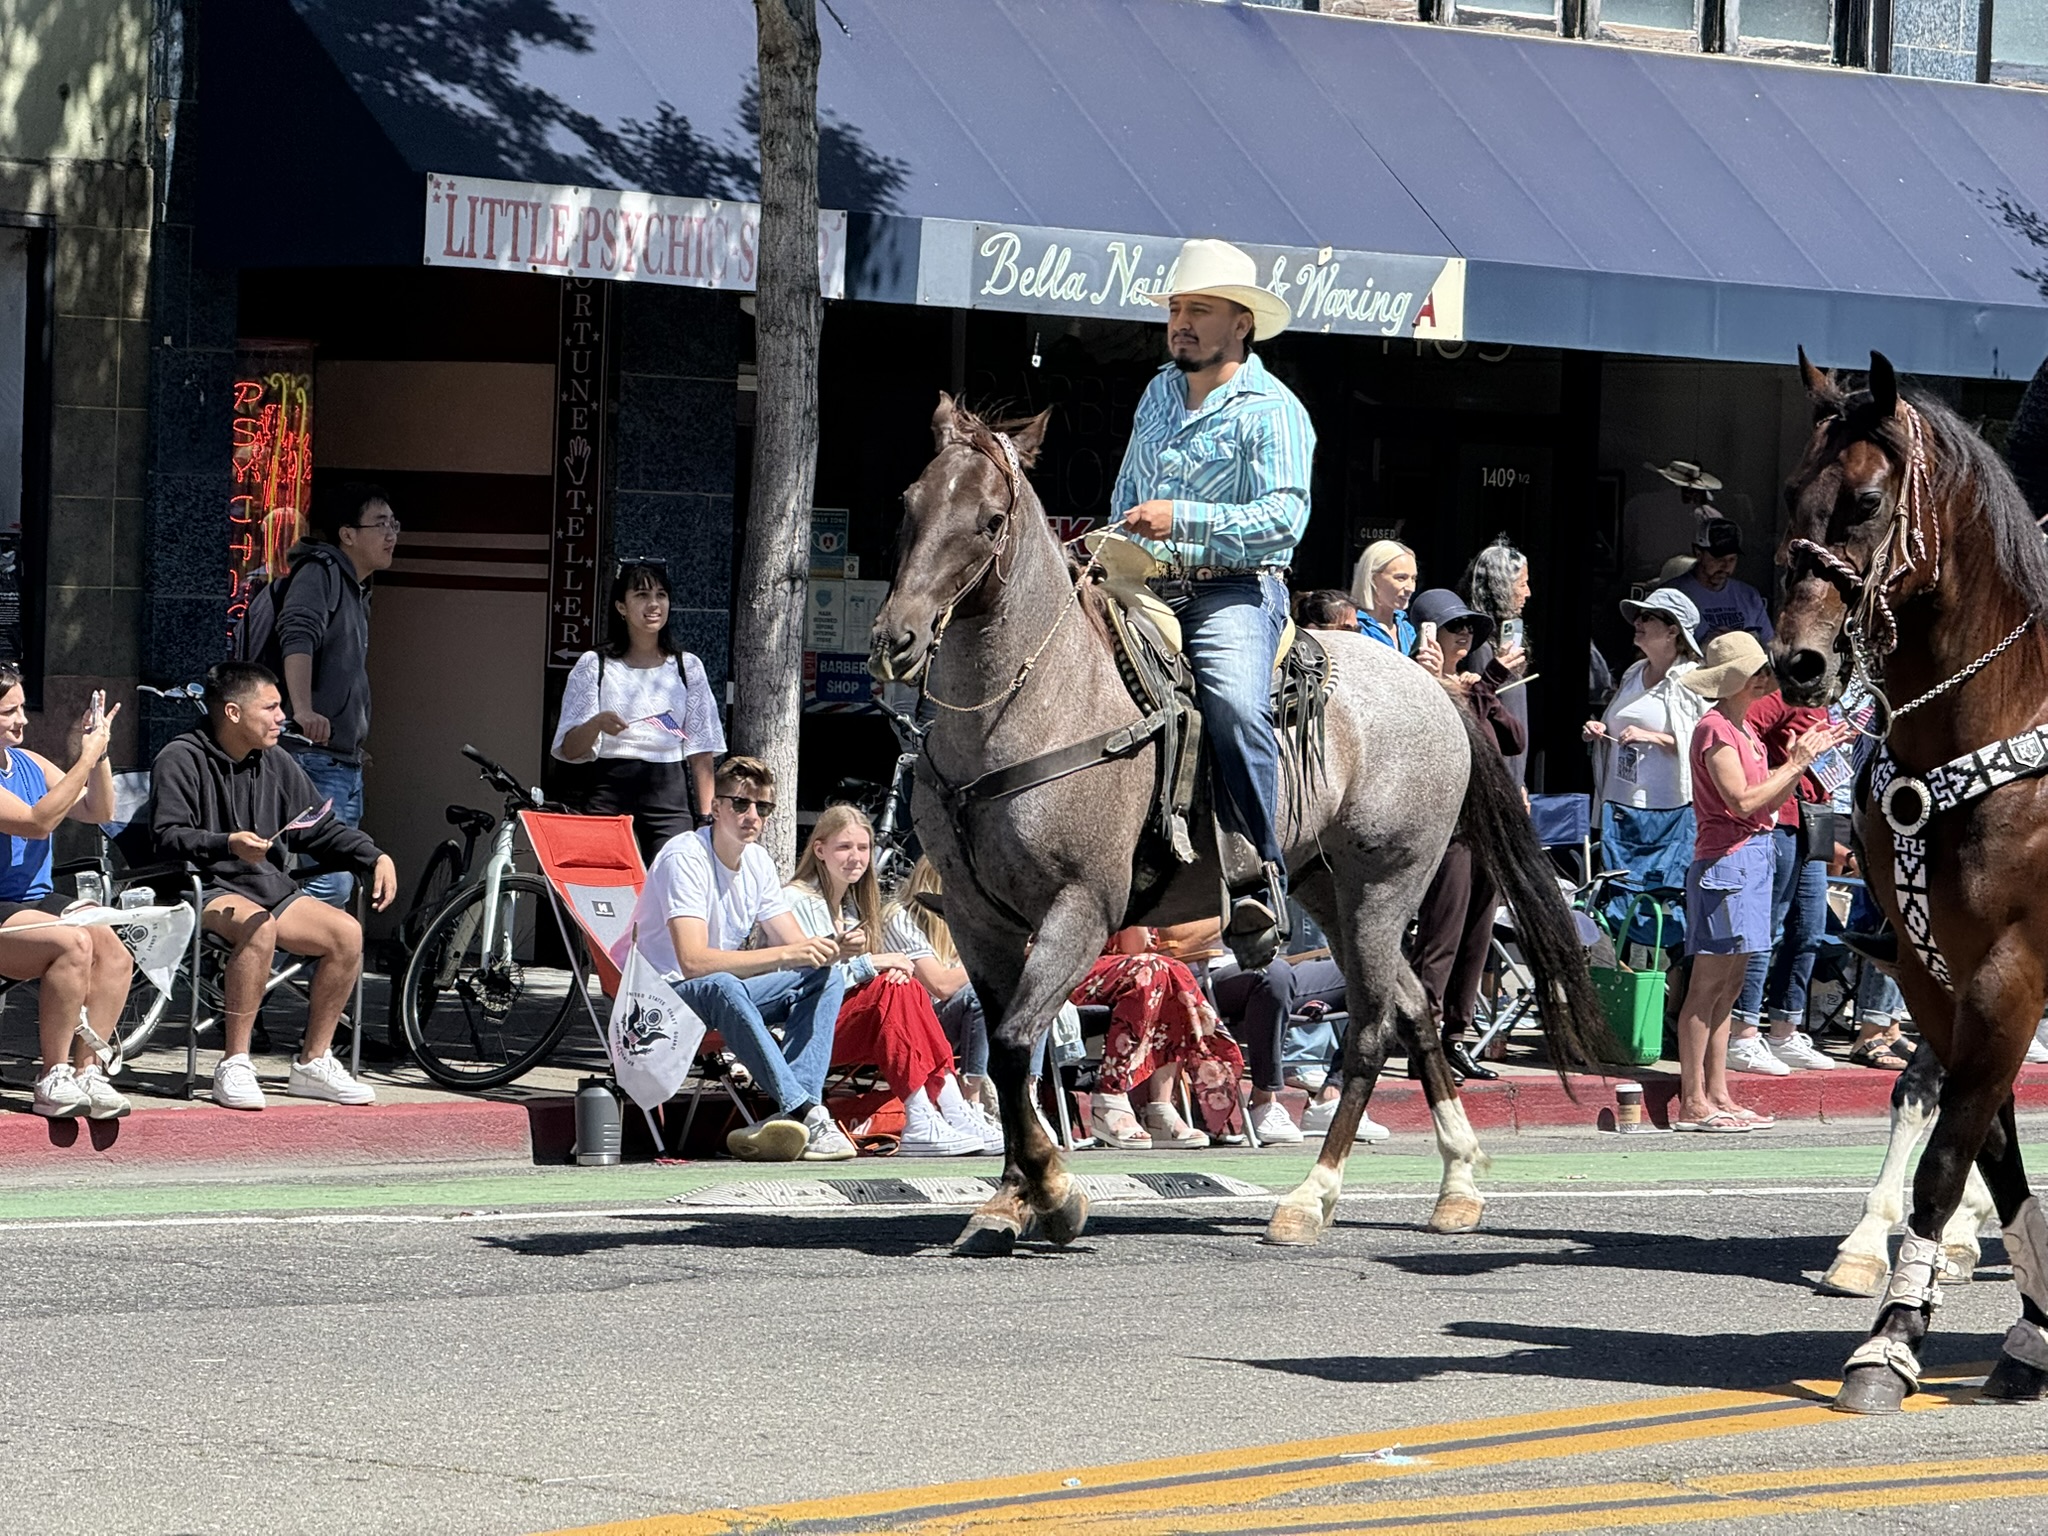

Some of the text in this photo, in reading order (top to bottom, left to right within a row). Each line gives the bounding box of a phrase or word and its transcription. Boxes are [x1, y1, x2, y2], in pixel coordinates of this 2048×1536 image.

[443, 193, 570, 268] LITTLE
[577, 205, 729, 282] PSYCHIC
[979, 231, 1413, 337] Bella Nail & Waxing
[1481, 466, 1531, 488] 1409 1/2
[1360, 527, 1396, 539] CLOSED
[560, 489, 587, 643] TELLER
[819, 659, 869, 675] BARBER
[826, 679, 860, 695] SHOP
